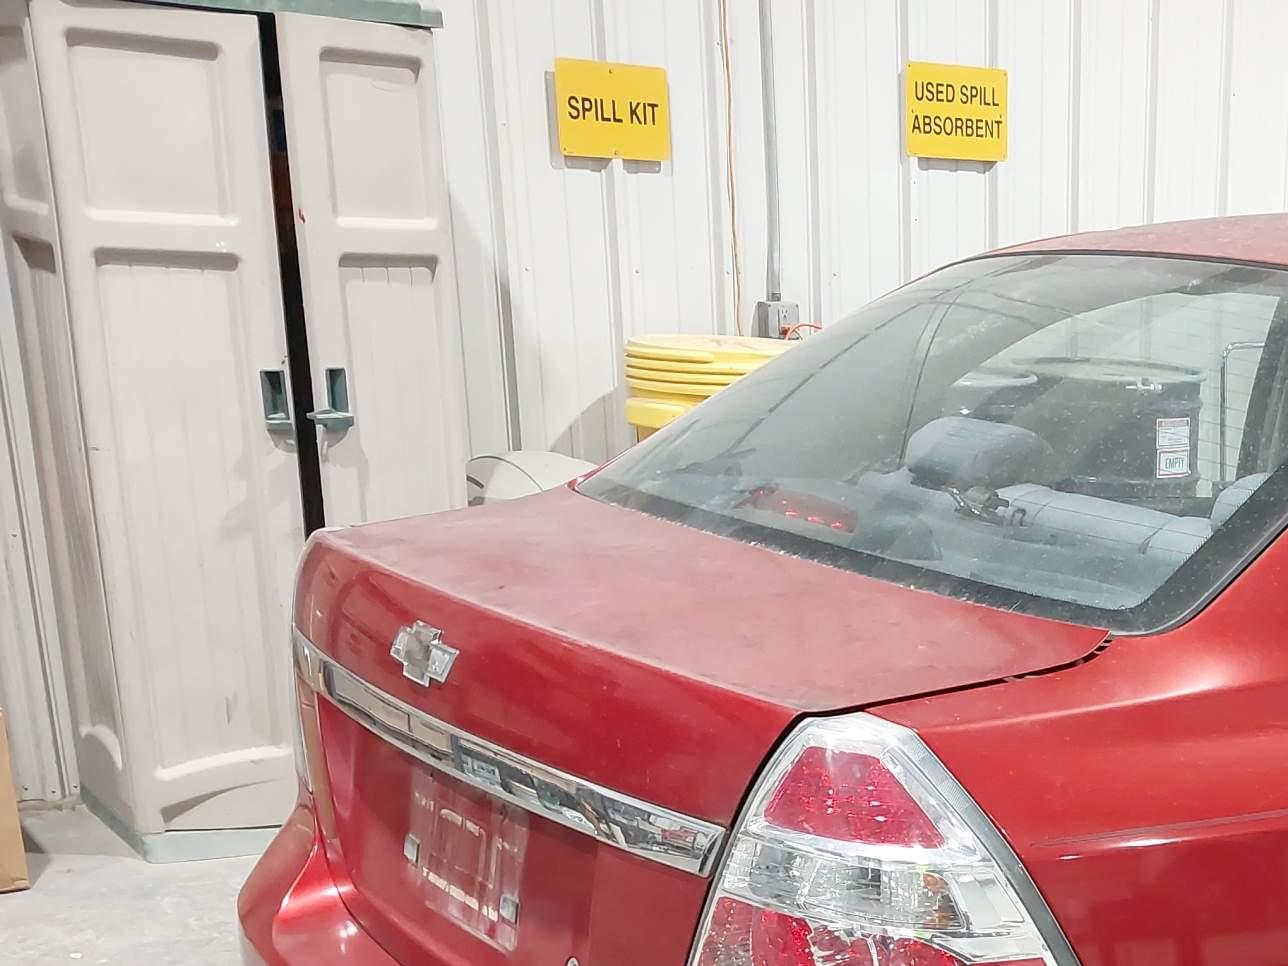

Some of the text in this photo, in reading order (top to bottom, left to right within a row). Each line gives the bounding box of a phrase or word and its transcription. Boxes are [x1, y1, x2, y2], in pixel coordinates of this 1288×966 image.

[915, 81, 999, 106] USED SPILL
[568, 95, 658, 125] SPILL KIT
[912, 114, 1003, 139] ABSORBENT
[1165, 457, 1185, 470] EMPTY
